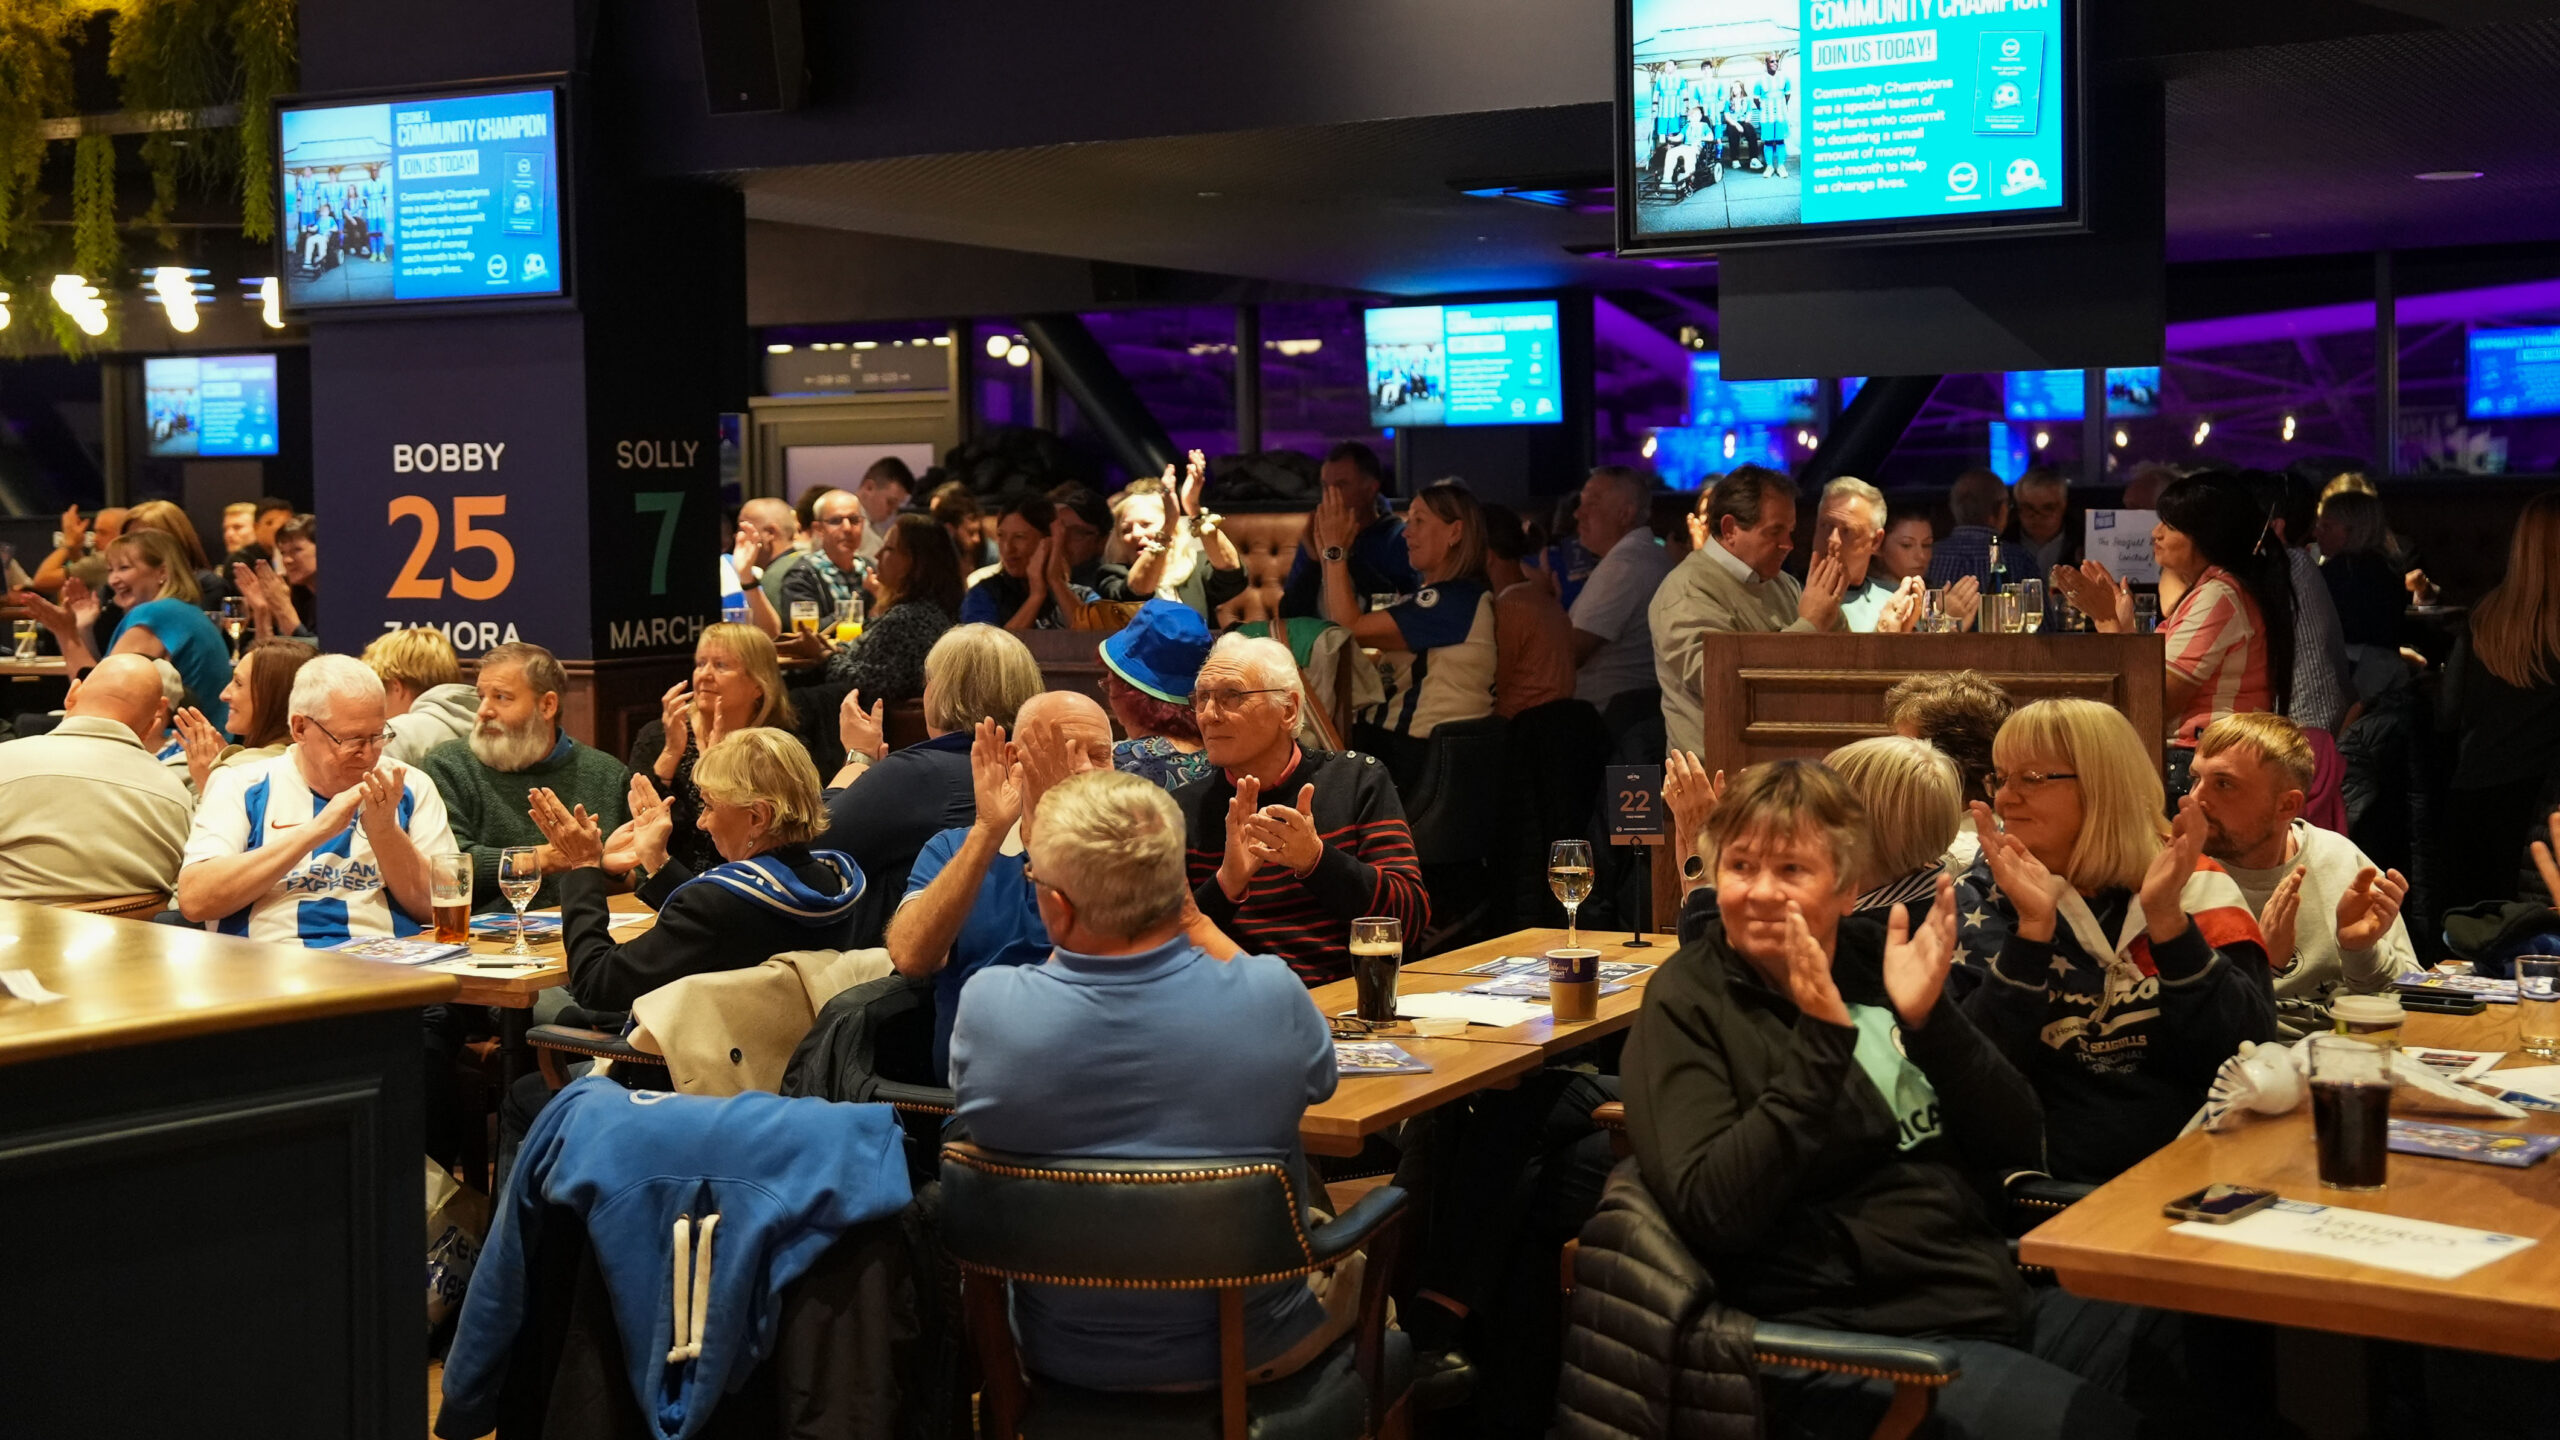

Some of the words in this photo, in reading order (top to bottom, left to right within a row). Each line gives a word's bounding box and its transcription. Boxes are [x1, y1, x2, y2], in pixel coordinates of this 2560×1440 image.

[1816, 44, 1847, 66] JOIN
[1851, 41, 1871, 63] US
[1875, 36, 1931, 61] TODAY!
[1812, 83, 1882, 100] Community
[1884, 78, 1953, 94] Champions
[1813, 104, 1833, 115] are
[1834, 104, 1842, 114] a
[1843, 98, 1886, 114] special
[1887, 98, 1919, 109] team
[1920, 93, 1934, 106] of
[397, 120, 476, 147] COMMUNITY
[477, 113, 547, 141] CHAMPION
[1813, 118, 1841, 133] loyal
[1842, 117, 1869, 128] fans
[1870, 114, 1897, 126] who
[1899, 109, 1945, 124] commit
[1813, 136, 1826, 147] to
[1827, 131, 1881, 145] donating
[1882, 132, 1890, 141] a
[1892, 126, 1924, 140] small
[402, 159, 422, 175] JOIN
[424, 157, 437, 174] US
[440, 153, 475, 172] TODAY!
[1813, 149, 1859, 162] amount
[1860, 146, 1874, 158] of
[1875, 145, 1917, 158] money
[1813, 165, 1843, 178] each
[1844, 162, 1884, 176] month
[1885, 161, 1898, 172] to
[1900, 158, 1927, 173] help
[400, 190, 445, 201] Community
[445, 187, 490, 199] Champions
[1814, 183, 1829, 194] us
[1830, 180, 1875, 193] change
[1876, 177, 1908, 190] lives.
[420, 201, 448, 214] special
[448, 200, 469, 211] team
[455, 212, 486, 223] commit
[411, 227, 445, 238] donating
[402, 241, 431, 251] amount
[441, 240, 468, 249] money
[393, 442, 505, 473] BOBBY
[616, 440, 699, 470] SOLLY
[386, 494, 516, 601] 25
[634, 491, 686, 595] 7
[384, 621, 521, 651] ORA
[609, 615, 704, 650] MARCH
[1619, 790, 1652, 812] 22
[287, 874, 382, 892] EXPRESS
[2089, 1035, 2147, 1053] SEAGULLS
